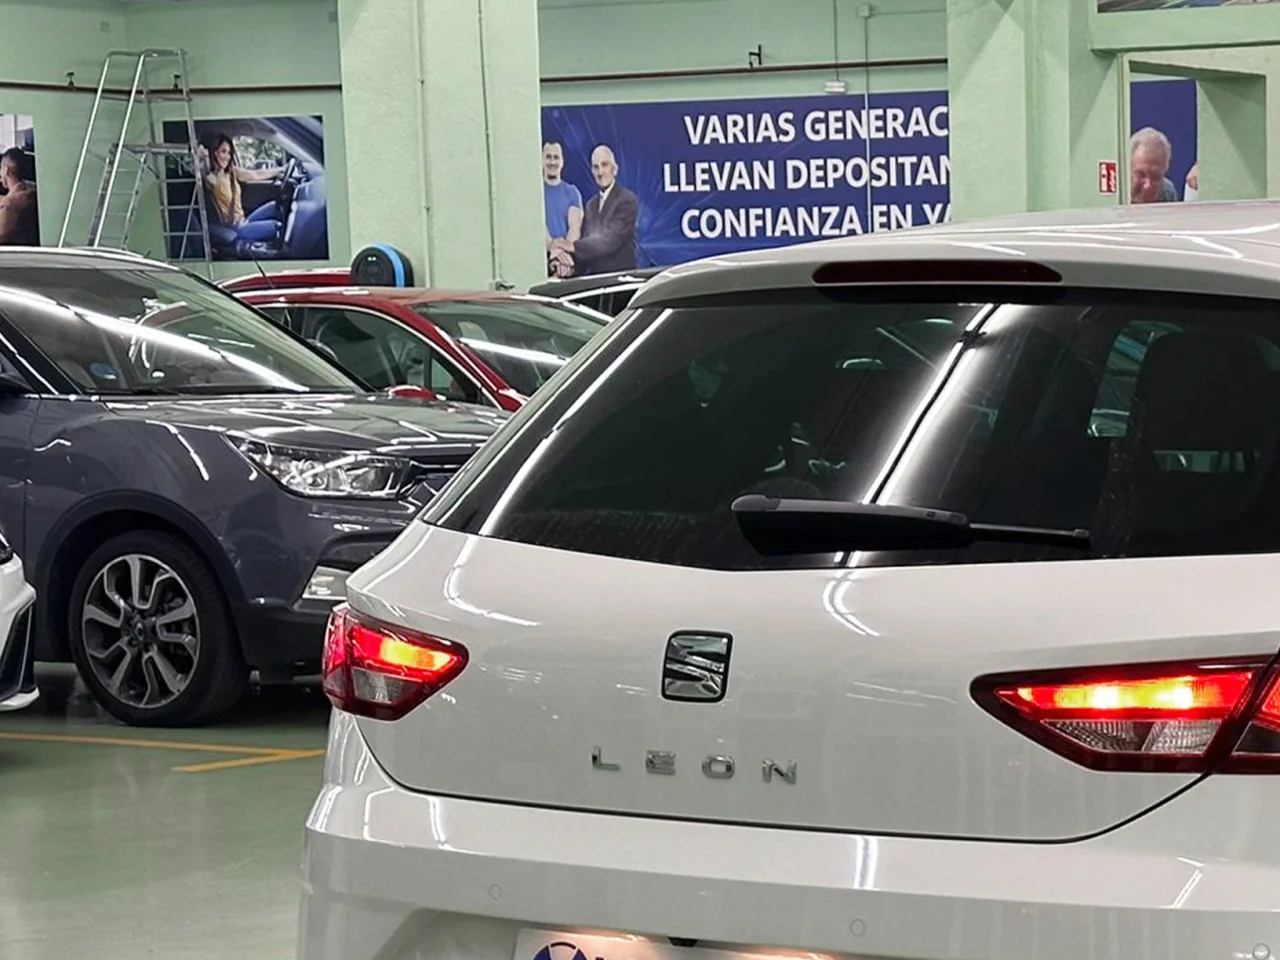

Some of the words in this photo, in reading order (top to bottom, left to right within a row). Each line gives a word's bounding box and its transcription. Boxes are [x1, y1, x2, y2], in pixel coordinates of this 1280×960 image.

[684, 112, 796, 145] VARIAS
[804, 106, 949, 141] GENERAC
[663, 160, 775, 192] LLEVAN
[681, 206, 863, 239] CONFIANZA
[873, 204, 913, 234] EN
[591, 745, 797, 785] LEON
